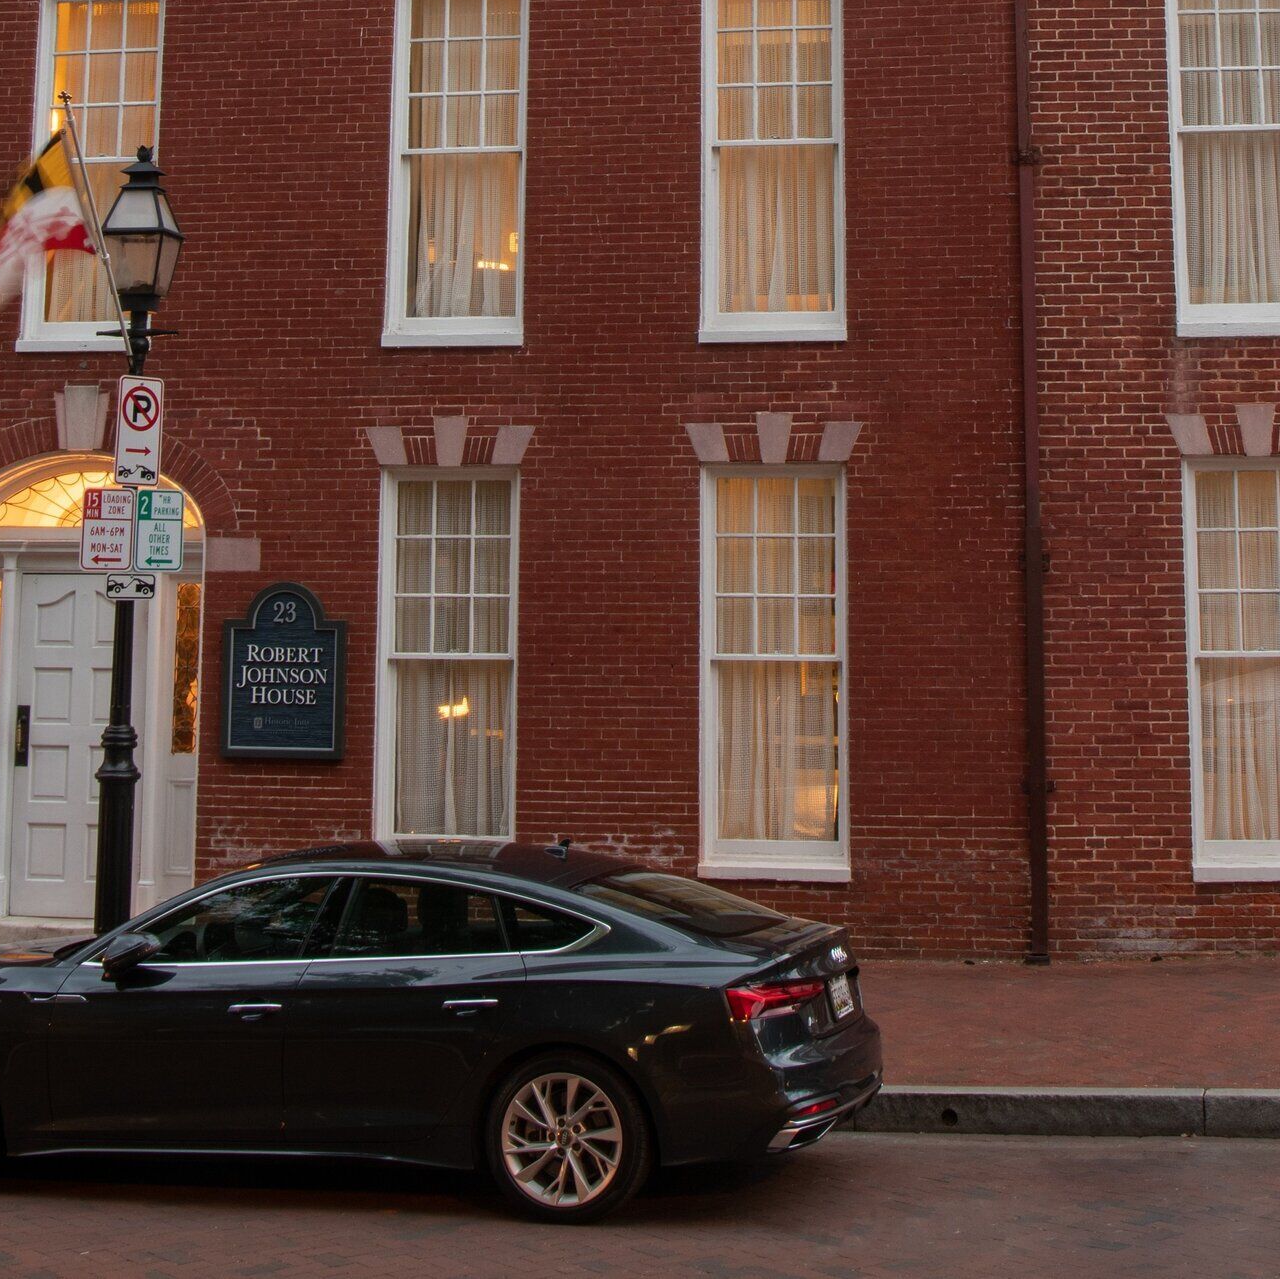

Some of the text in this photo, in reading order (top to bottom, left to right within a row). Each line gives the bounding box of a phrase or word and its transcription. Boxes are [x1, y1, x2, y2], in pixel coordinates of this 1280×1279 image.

[87, 492, 99, 507] 15
[103, 494, 132, 505] LOADING
[163, 496, 172, 505] HR
[108, 506, 126, 515] ZONE
[140, 496, 149, 515] 2
[86, 508, 99, 518] MIN
[154, 507, 180, 516] PARKING
[90, 526, 125, 537] 6AM-6PM
[153, 523, 166, 532] ALL
[149, 534, 171, 544] OTHER
[90, 543, 123, 553] MON-SAT
[149, 546, 169, 556] TIMES
[273, 601, 297, 624] 23
[246, 644, 324, 663] ROBERT
[236, 665, 329, 689] JOHNSON
[250, 686, 317, 705] HOUSE
